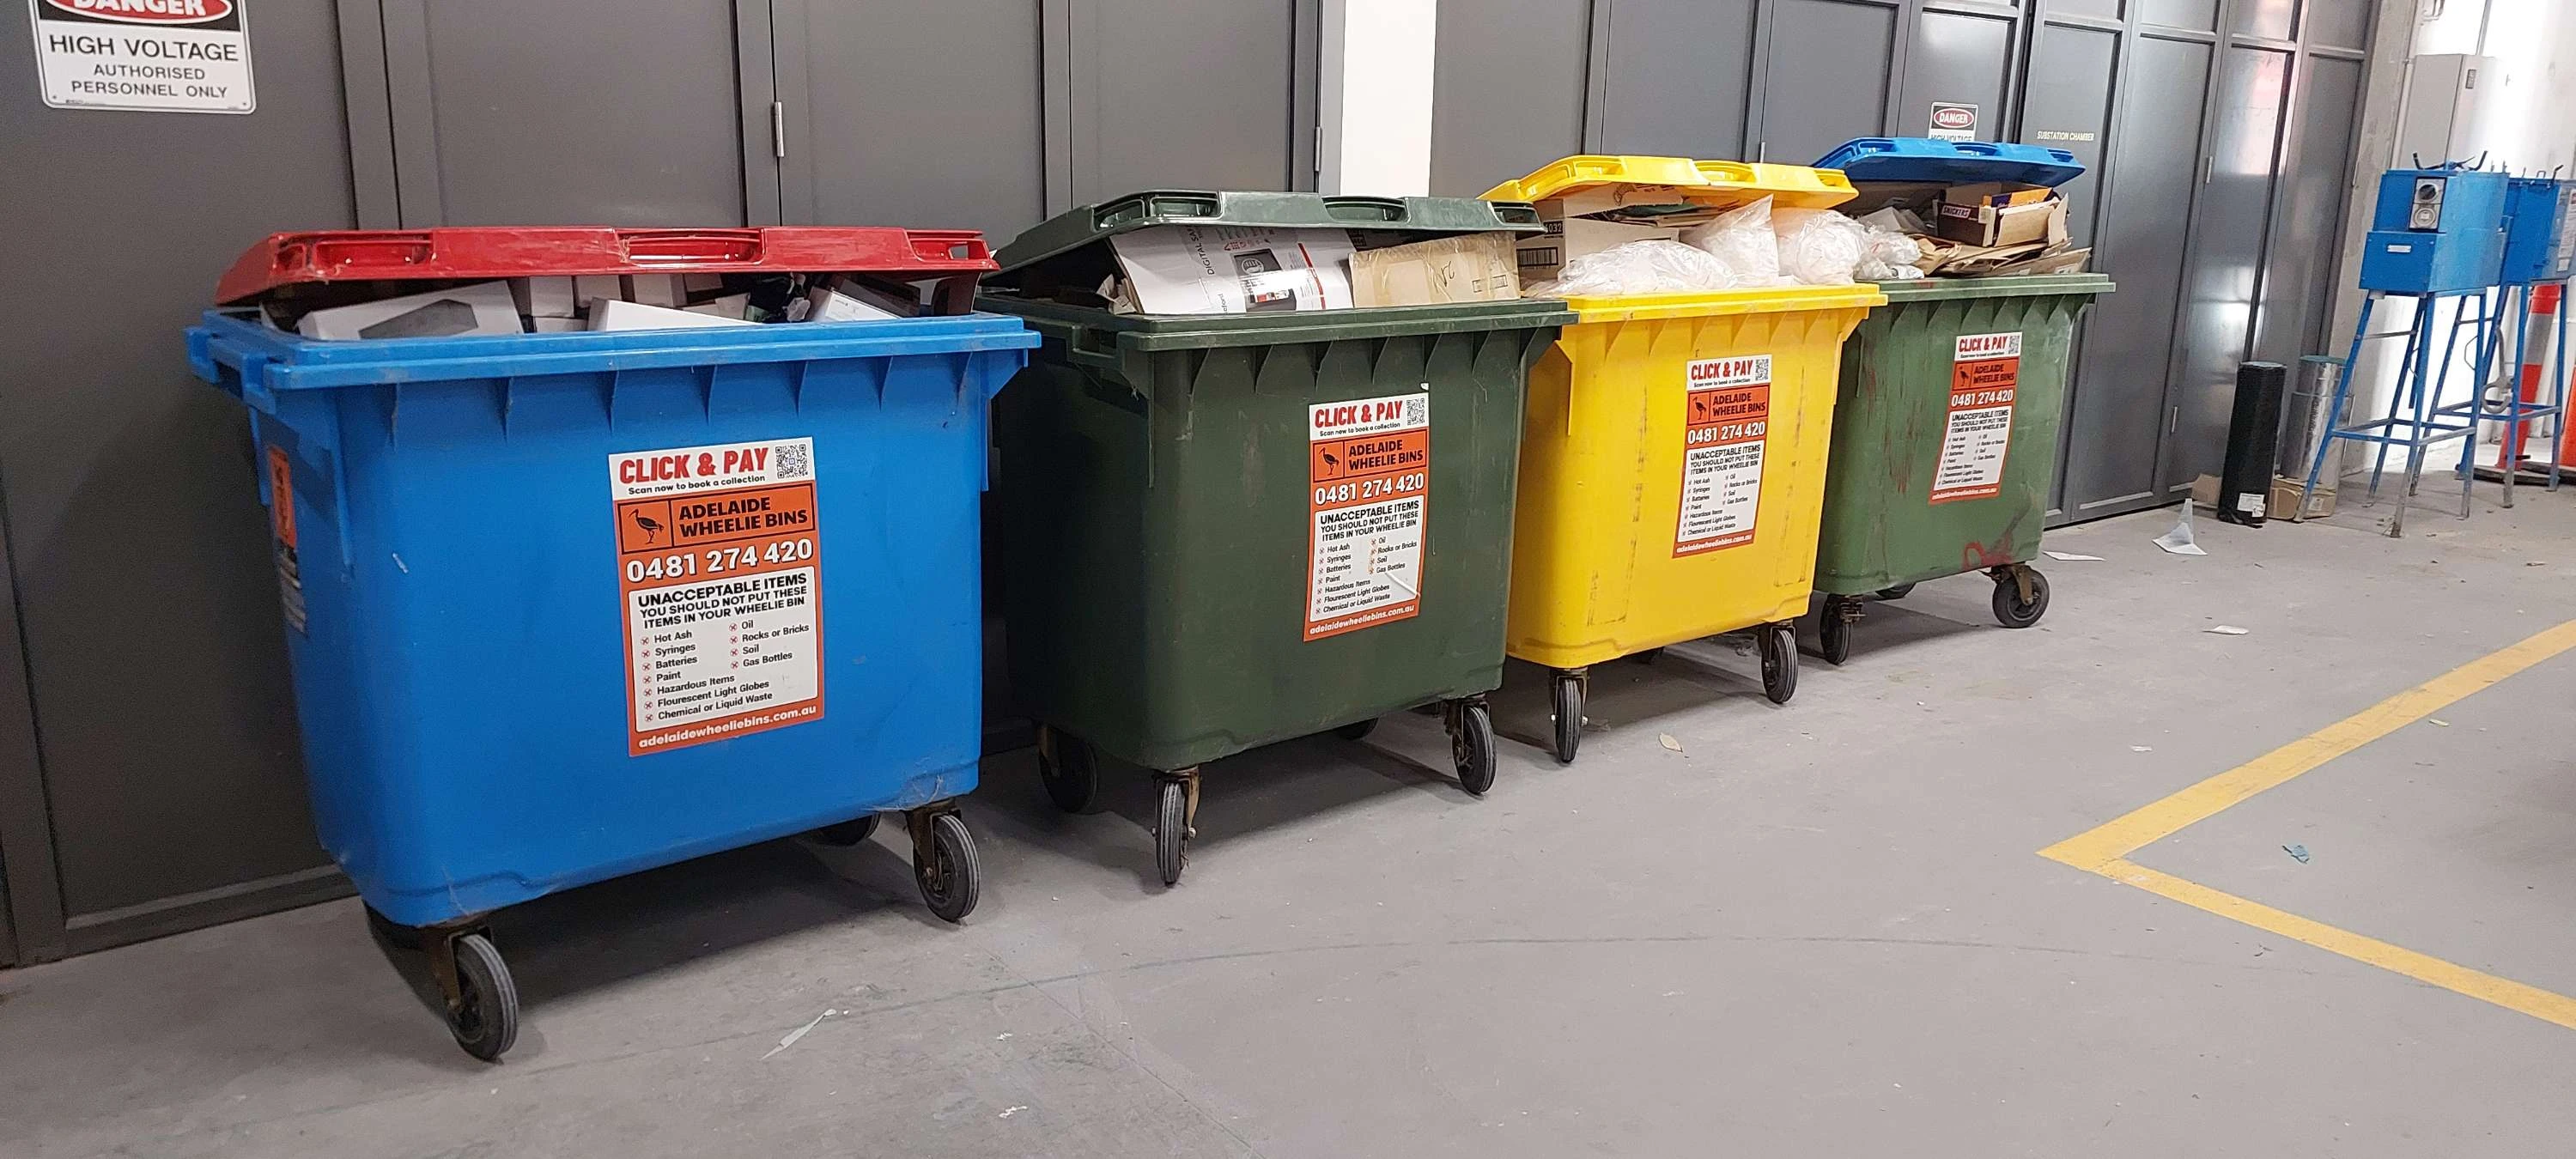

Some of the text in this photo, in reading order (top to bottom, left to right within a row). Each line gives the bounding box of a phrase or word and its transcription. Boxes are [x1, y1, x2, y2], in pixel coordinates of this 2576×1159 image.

[50, 34, 239, 62] HIGH VOLTAGE
[93, 64, 205, 81] AUTHORISED
[71, 81, 228, 99] PERSONNEL ONLY
[1939, 112, 1968, 124] DANGER
[2037, 130, 2094, 142] SUBSTATION CHAMBER
[1943, 206, 1969, 216] SNICKERS
[1194, 243, 1215, 276] DIGITAL
[1959, 336, 2008, 352] CLICK & PAY
[1691, 360, 1753, 379] CLICK & PAY
[1974, 363, 2003, 373] ADELAIDE
[1712, 392, 1751, 405] ADELAIDE
[1951, 389, 2013, 406] 0481 274 420
[1315, 400, 1402, 428] CLICK & PAY
[1712, 402, 1765, 416] WHEELIE BINS
[1687, 422, 1765, 444] 0481 274 420
[1348, 439, 1402, 457] ADELAIDE
[1690, 444, 1760, 460] UNACCEPTABLE ITEMS
[619, 447, 768, 483] CLICK & PAY
[1348, 450, 1423, 470] WHEELIE BINS
[688, 480, 710, 488] book
[720, 475, 765, 485] collection
[1315, 472, 1424, 504] 0481 274 420
[679, 497, 769, 519] ADELAIDE
[1320, 500, 1419, 524] UNACCEPTABLE ITEMS
[680, 509, 807, 537] WHEELIE BINS
[1321, 510, 1418, 532] YOU SHOULD NOT PUT THESE
[1322, 531, 1344, 541] ITEMS
[1354, 526, 1374, 536] YOUR
[1376, 520, 1404, 531] WHEELIE
[627, 538, 811, 581] 0481 274 420
[1327, 554, 1351, 564] Syringes
[1326, 563, 1351, 573] Batteries
[1325, 574, 1340, 583] Paint
[638, 573, 806, 606] UNACCEPTABLE ITEMS
[1323, 591, 1356, 603] Flourescent
[1357, 587, 1370, 596] Light
[1324, 583, 1353, 592] Hazardous
[640, 586, 806, 618] YOU SHOULD NOT PUT THESE
[1322, 601, 1348, 612] Chemical
[1356, 596, 1373, 605] Liquid
[644, 596, 804, 628] ITEMS IN YOUR WHEELIE BIN
[741, 619, 753, 629] Oil
[742, 630, 769, 641] Rocks
[782, 624, 809, 634] Bricks
[653, 630, 692, 643] Hot Ash
[655, 644, 695, 657] Syringes
[742, 644, 759, 654] Soil
[762, 652, 792, 663] Bottles
[655, 656, 697, 669] Batteries
[656, 671, 681, 682] Paint
[657, 675, 734, 694] Hazardous Items
[657, 681, 769, 707] Flourescent Light Globes
[658, 705, 701, 719] Chemical
[715, 696, 743, 709] Liquid
[745, 693, 772, 703] Waste
[639, 706, 816, 747] adelaidewheeliebins.com.au
